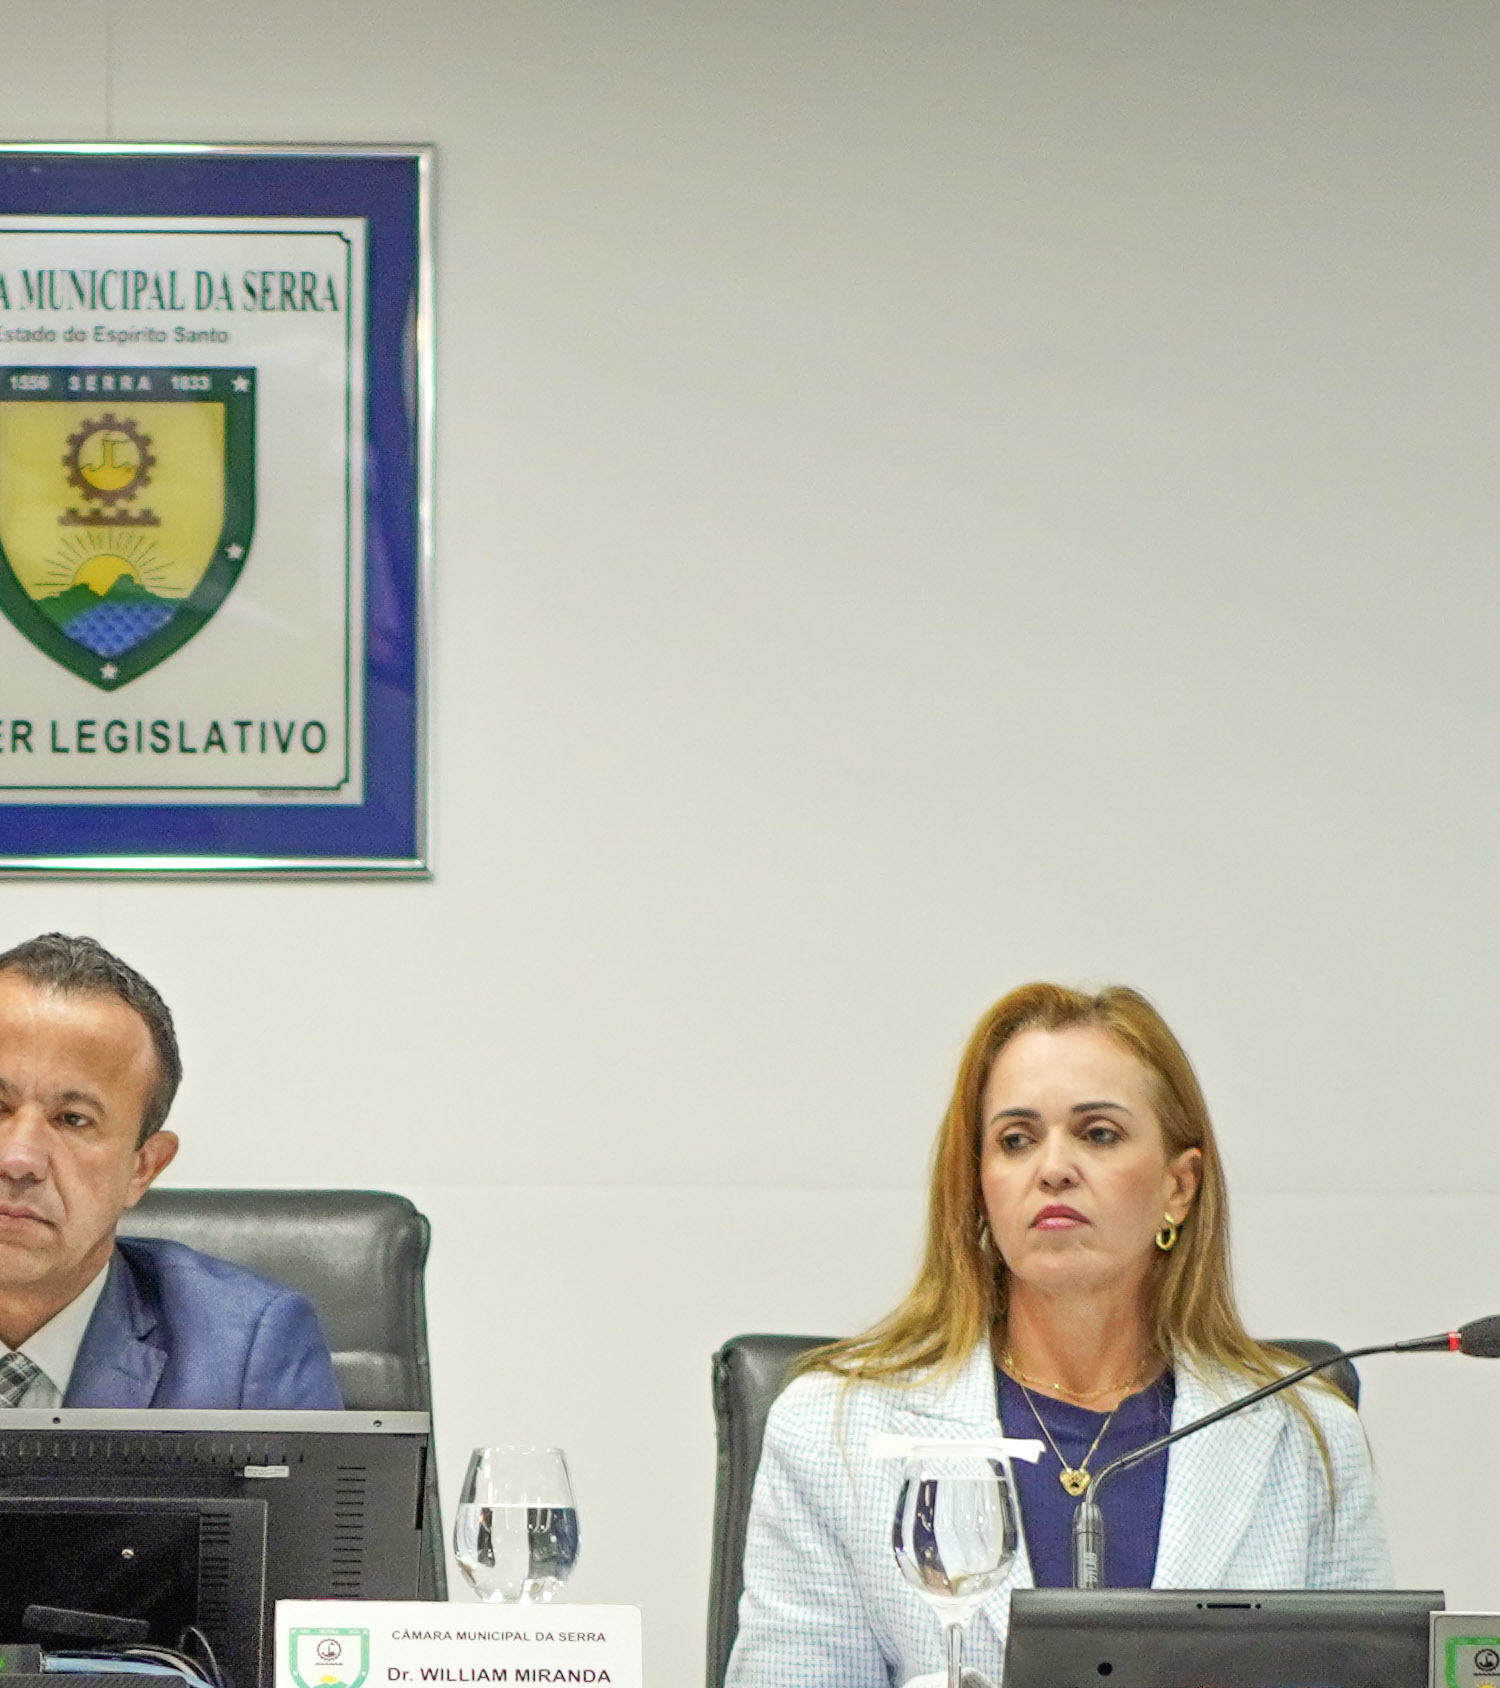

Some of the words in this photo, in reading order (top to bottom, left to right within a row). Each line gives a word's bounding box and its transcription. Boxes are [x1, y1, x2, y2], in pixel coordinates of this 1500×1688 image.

[21, 268, 185, 312] MUNICIPAL
[195, 269, 234, 312] DA
[243, 269, 340, 313] SERRA
[63, 327, 87, 344] do
[93, 325, 168, 348] Espírito
[174, 326, 229, 344] Santo
[67, 375, 152, 392] SERRA
[50, 719, 328, 755] LEGISLATIVO
[392, 1628, 452, 1642] CÂMARA
[456, 1630, 531, 1642] MUNICIPAL
[535, 1631, 554, 1642] DA
[558, 1631, 606, 1642] SERRA
[388, 1667, 414, 1682] Dr.
[421, 1667, 508, 1683] WILLIAM
[515, 1668, 611, 1683] MIRANDA
